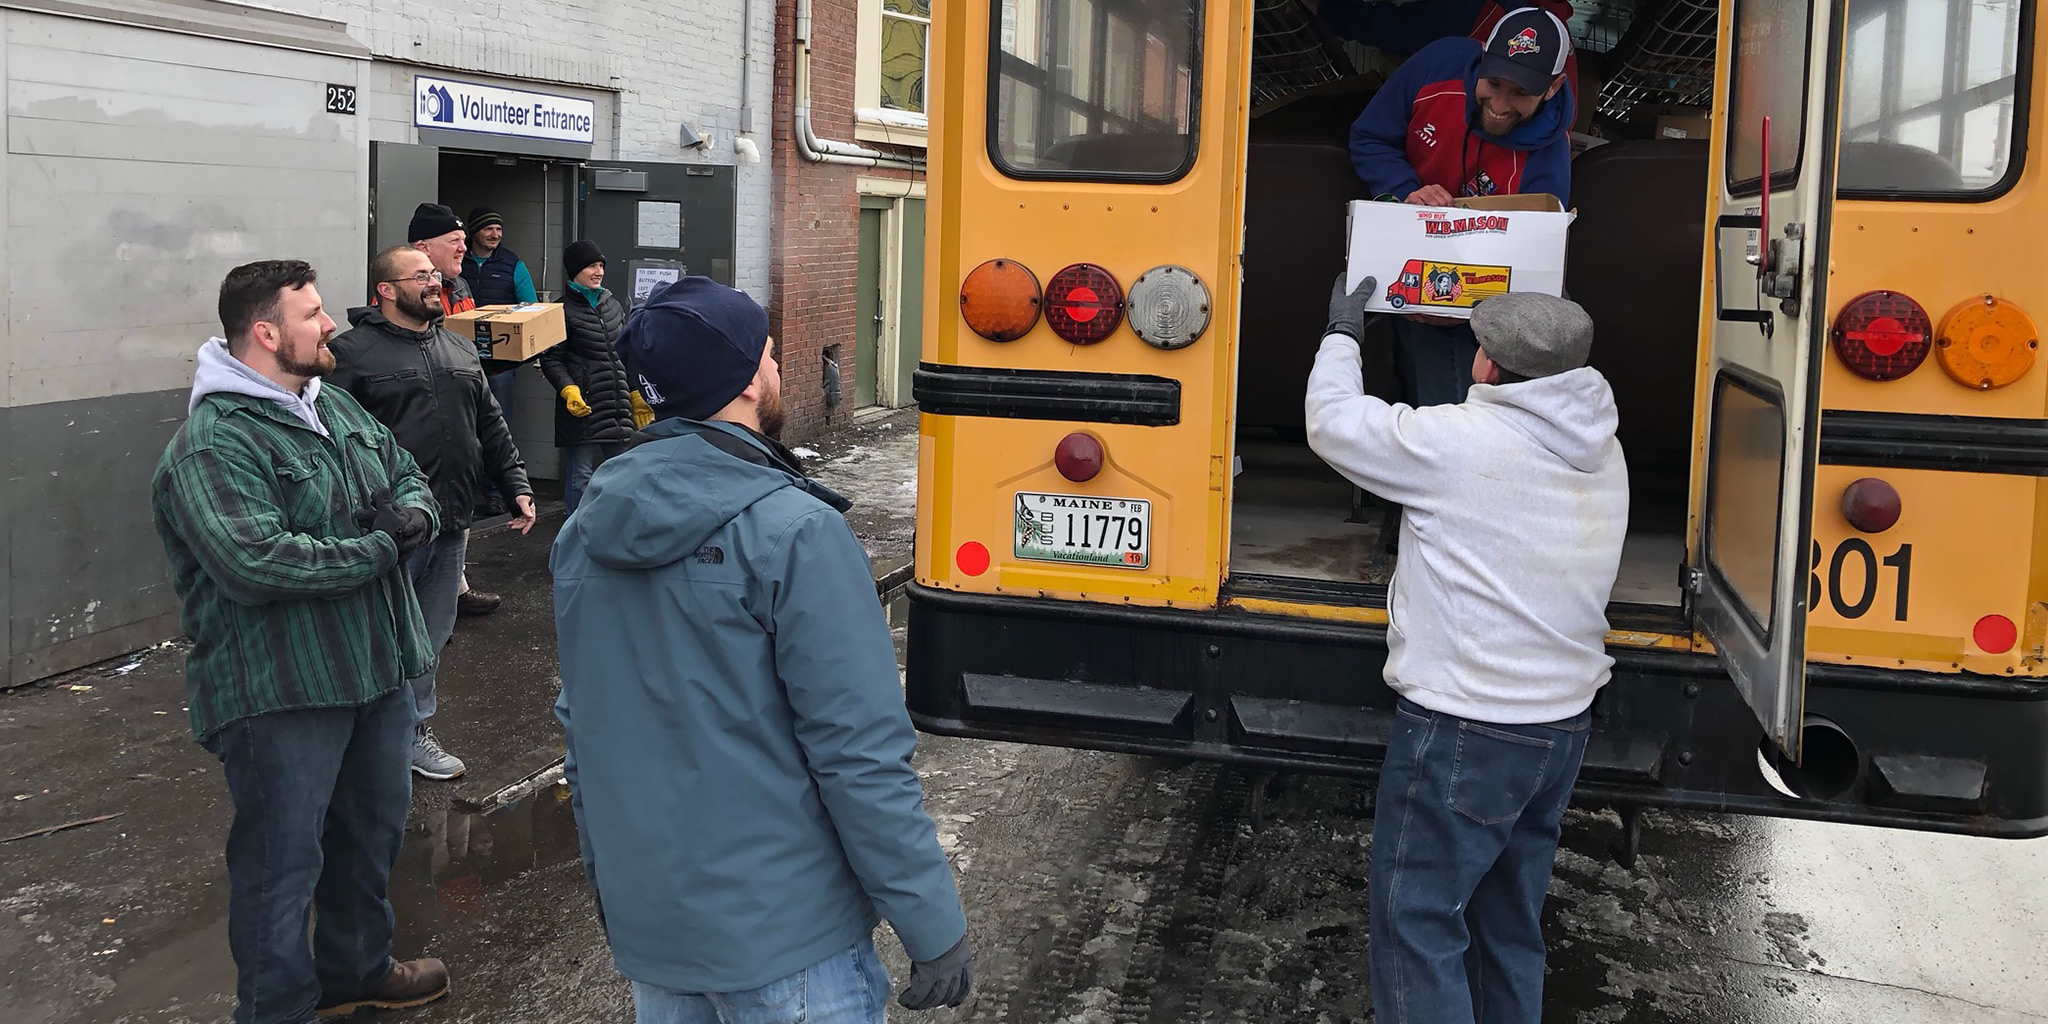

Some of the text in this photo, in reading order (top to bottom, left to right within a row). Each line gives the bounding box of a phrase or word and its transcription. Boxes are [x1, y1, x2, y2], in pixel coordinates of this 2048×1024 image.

[327, 86, 355, 112] 252
[460, 94, 590, 132] Volunteer Entrance
[1053, 498, 1142, 513] MAINE FEB
[1041, 512, 1053, 546] BUS
[1065, 513, 1142, 551] 11779
[1053, 550, 1141, 563] Vacationland 19
